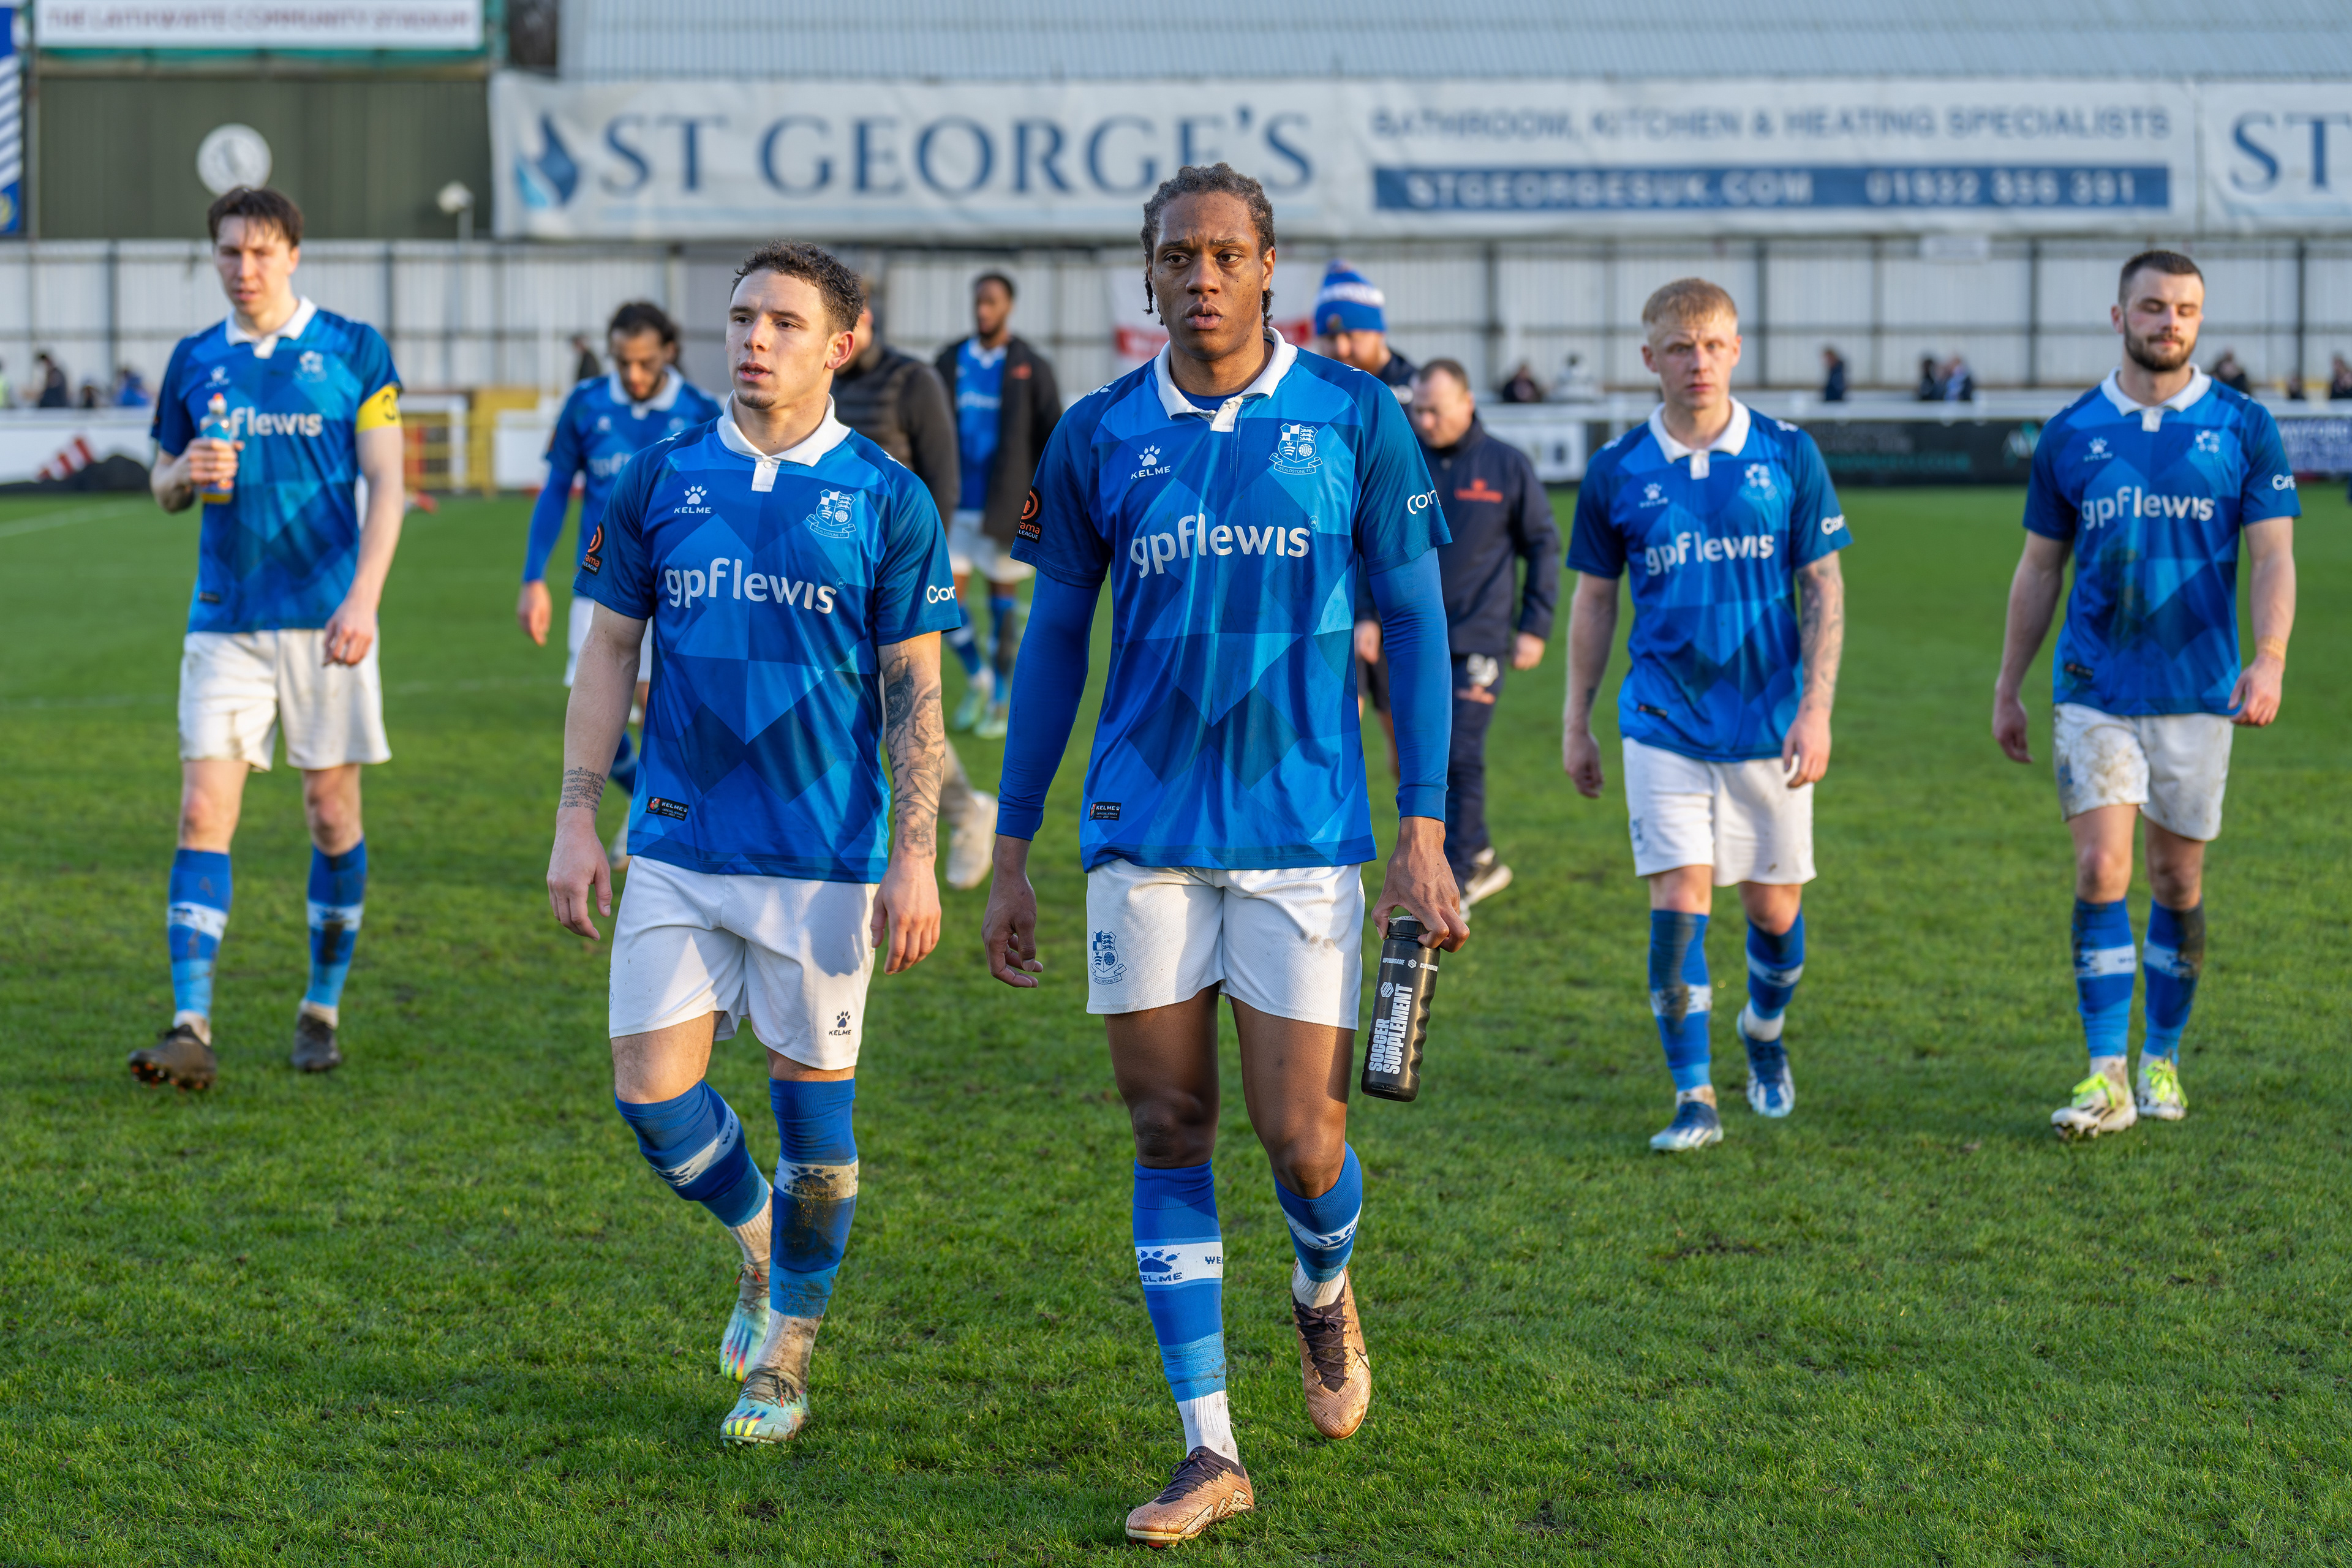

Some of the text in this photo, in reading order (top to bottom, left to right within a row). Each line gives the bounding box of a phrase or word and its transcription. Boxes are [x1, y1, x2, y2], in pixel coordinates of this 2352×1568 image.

[232, 8, 369, 29] COMMUNITY
[1591, 108, 1741, 138] KITCHEN
[1752, 108, 1774, 138] &
[1785, 108, 1937, 137] HEATING
[1945, 108, 2171, 138] SPECIALISTS
[598, 104, 1314, 198] ST GEORGE'S
[2228, 110, 2352, 197] ST
[1407, 172, 1813, 206] STGEORGESUK.COM
[231, 406, 323, 437] flewis
[1131, 466, 1171, 480] KELME
[2081, 485, 2215, 530] gpflewis
[1019, 529, 1038, 540] LEAGUE
[1020, 522, 1040, 534] ama
[1130, 513, 1310, 578] gpflewis
[1645, 531, 1774, 576] gpflewis
[665, 557, 837, 614] gpflewis
[662, 802, 684, 812] KELME
[1368, 1019, 1390, 1072] SOCCER
[1382, 983, 1413, 1075] SUPPLEMENT
